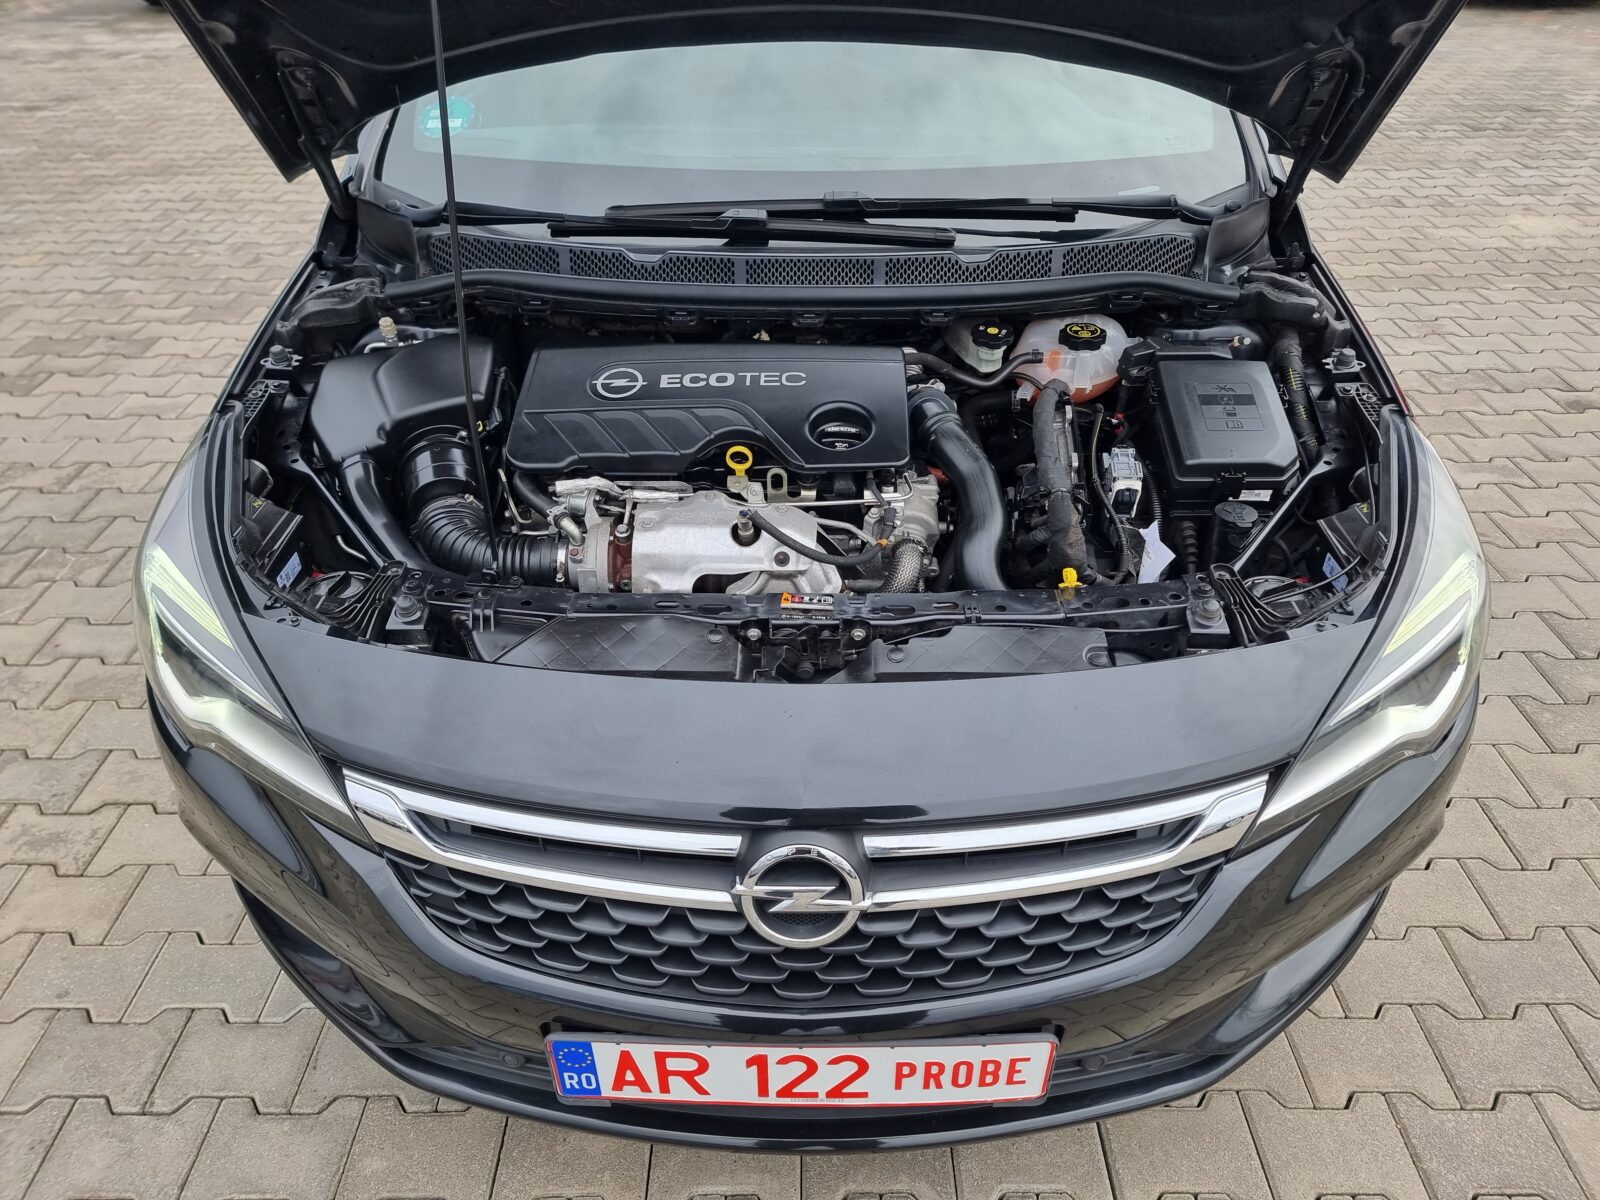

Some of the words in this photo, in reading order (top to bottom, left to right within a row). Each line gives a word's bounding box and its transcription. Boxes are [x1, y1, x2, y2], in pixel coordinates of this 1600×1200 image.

[659, 371, 807, 388] ECOTEC
[563, 1072, 597, 1090] RO
[611, 1049, 712, 1095] AR
[745, 1053, 870, 1099] 122
[894, 1057, 1031, 1090] PROBE
